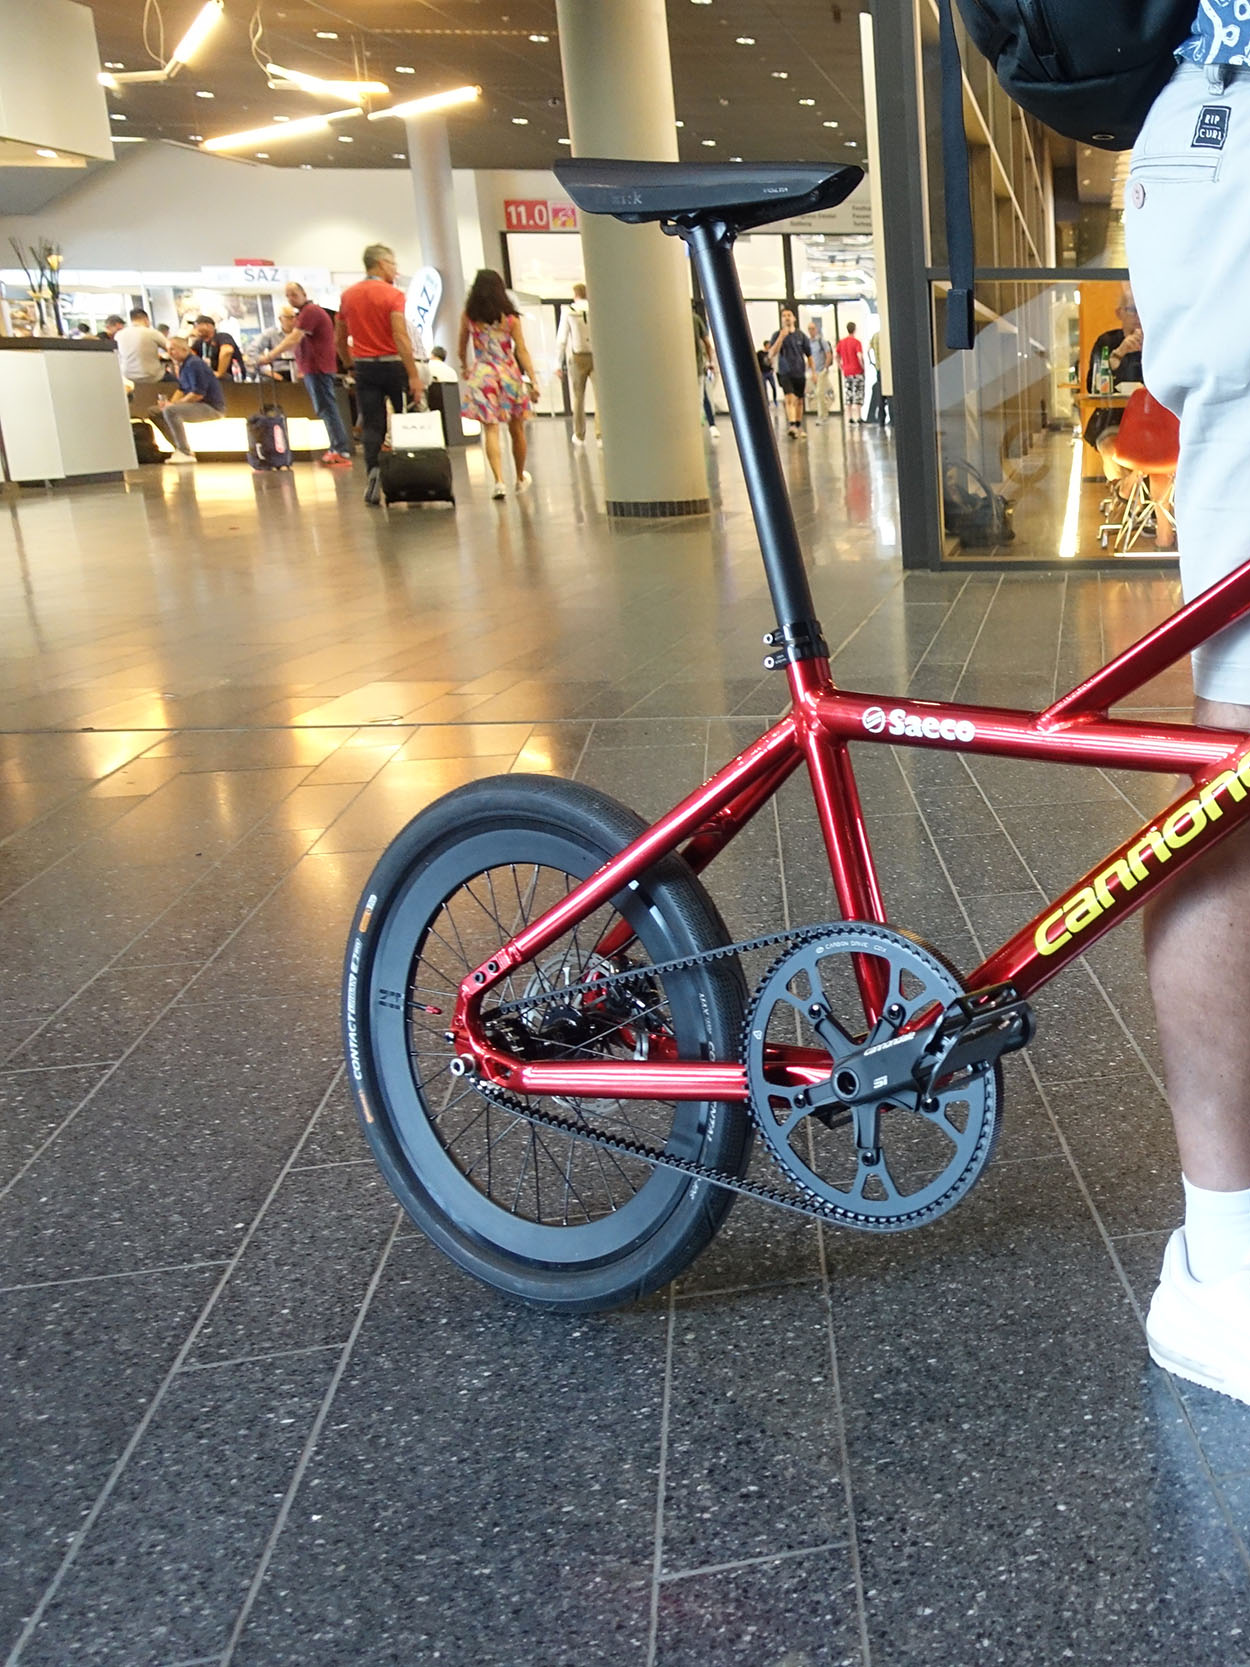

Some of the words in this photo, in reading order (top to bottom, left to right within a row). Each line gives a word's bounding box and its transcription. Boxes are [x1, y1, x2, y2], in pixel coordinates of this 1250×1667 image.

[1204, 114, 1220, 125] RIP
[1200, 128, 1222, 141] CURL
[507, 204, 547, 226] 11.0
[244, 268, 280, 283] SAZ
[888, 708, 976, 743] Saeco
[347, 1013, 363, 1080] CONTACT
